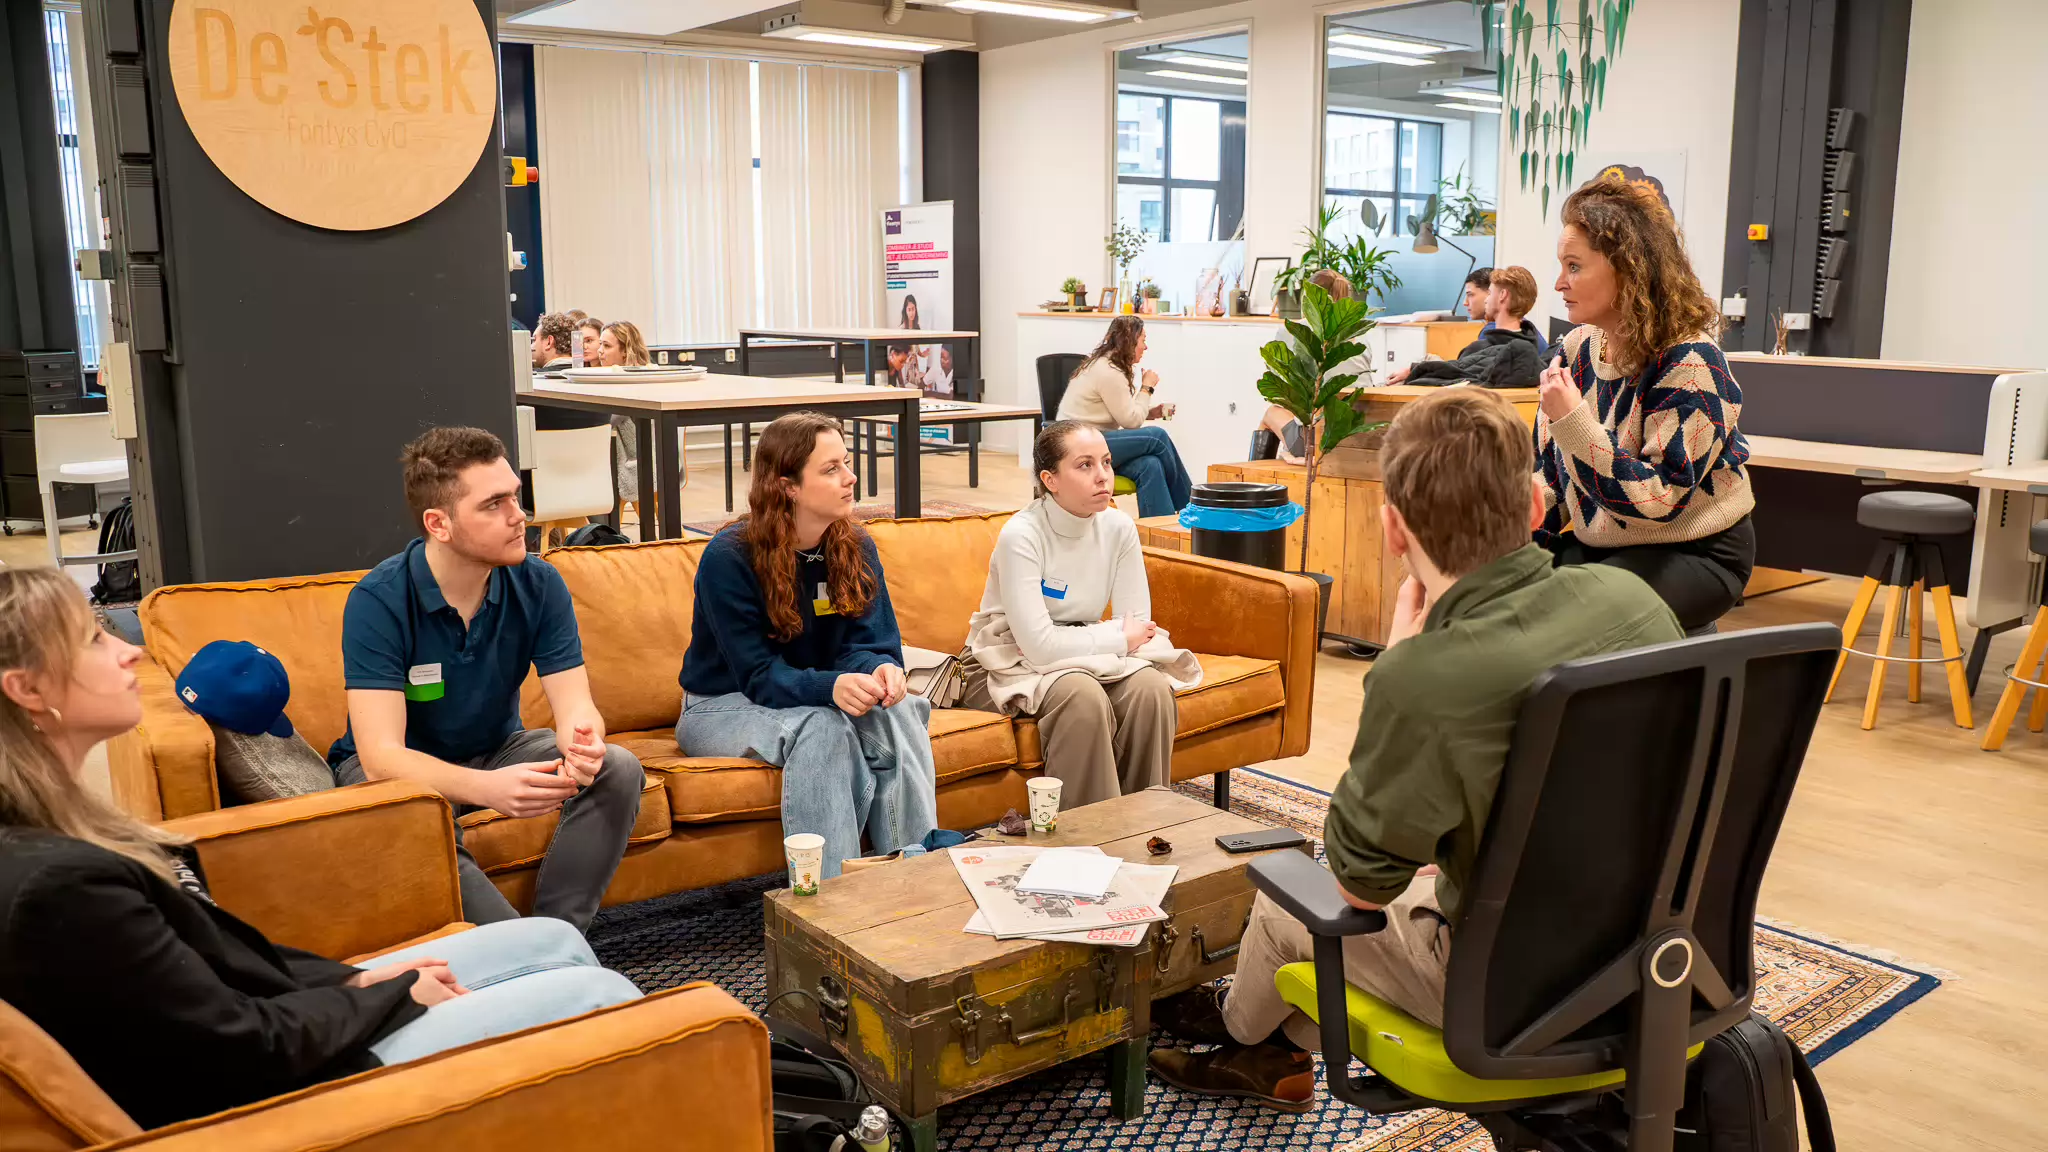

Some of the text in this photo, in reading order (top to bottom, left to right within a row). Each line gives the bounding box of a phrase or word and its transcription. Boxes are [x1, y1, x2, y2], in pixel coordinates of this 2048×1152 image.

[193, 7, 478, 115] De Stek
[287, 115, 407, 149] Fontys CvO
